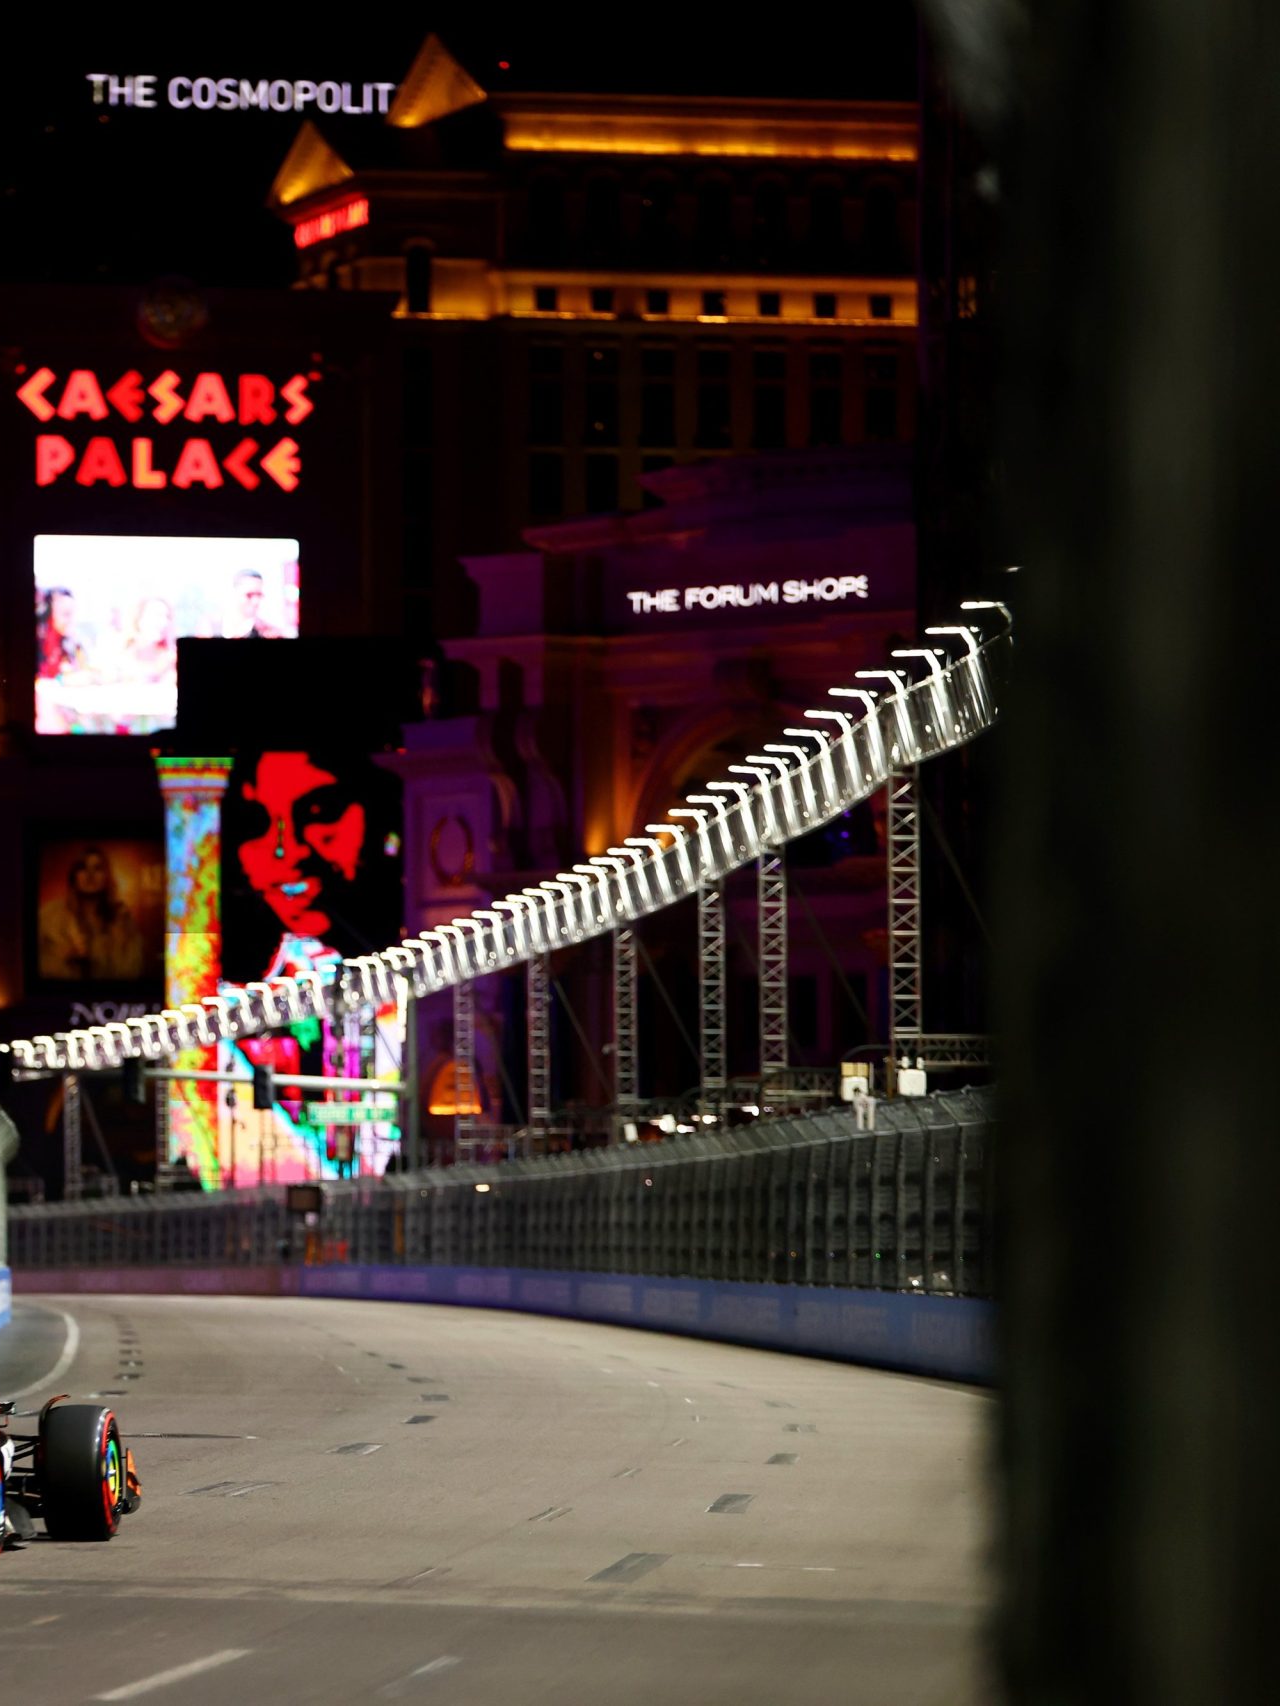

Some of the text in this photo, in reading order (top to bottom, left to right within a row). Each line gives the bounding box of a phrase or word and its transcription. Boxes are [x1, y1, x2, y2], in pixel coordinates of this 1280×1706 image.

[85, 73, 396, 114] THE COSMOPOLIT
[16, 367, 314, 426] CAESARS
[35, 434, 302, 493] PALACE
[627, 588, 681, 614] THE
[684, 581, 780, 610] FORUM
